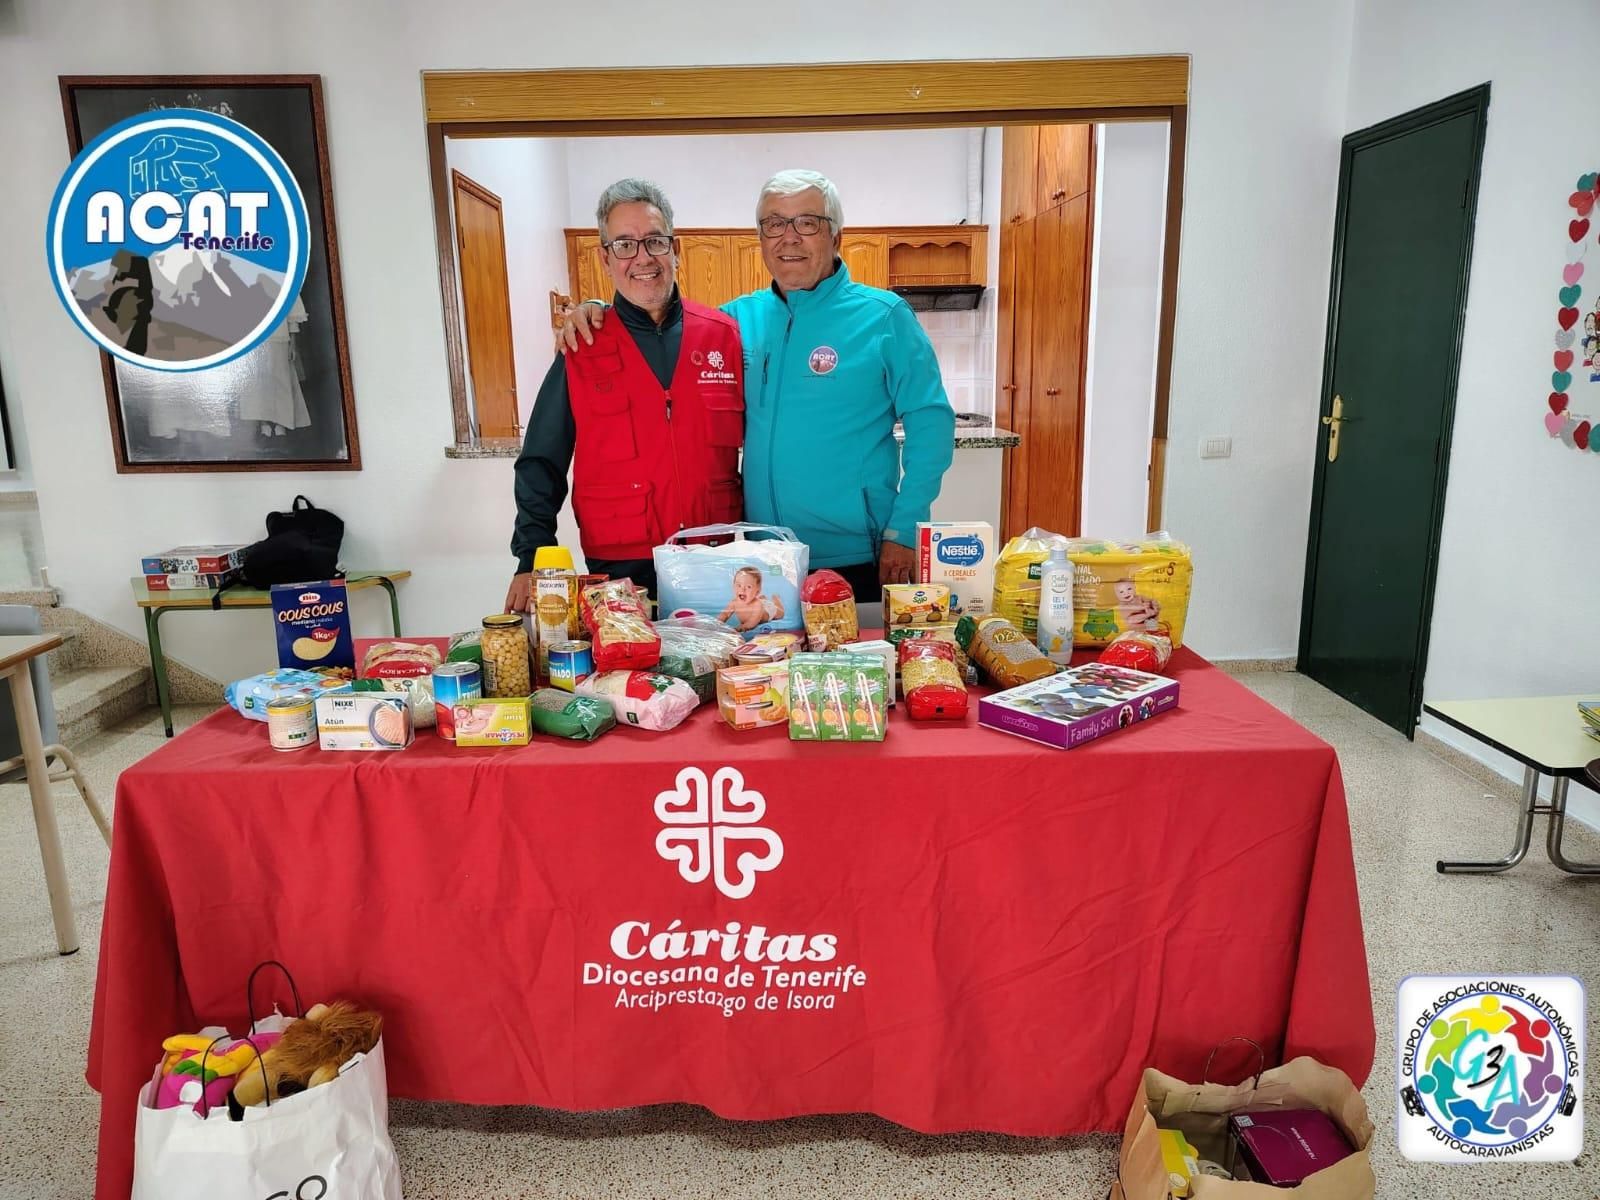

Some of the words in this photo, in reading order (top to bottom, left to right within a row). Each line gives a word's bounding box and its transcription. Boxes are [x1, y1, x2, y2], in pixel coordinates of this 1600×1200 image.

[700, 370, 735, 379] Cáritas
[278, 607, 311, 623] COUS
[311, 601, 344, 617] COUS
[1071, 721, 1099, 743] Family
[1101, 714, 1114, 731] Set
[609, 919, 838, 963] Cáritas
[582, 962, 719, 986] Diocesana
[724, 964, 755, 989] de
[761, 964, 867, 993] Tenerife
[754, 990, 779, 1010] de
[787, 990, 836, 1010] Isora
